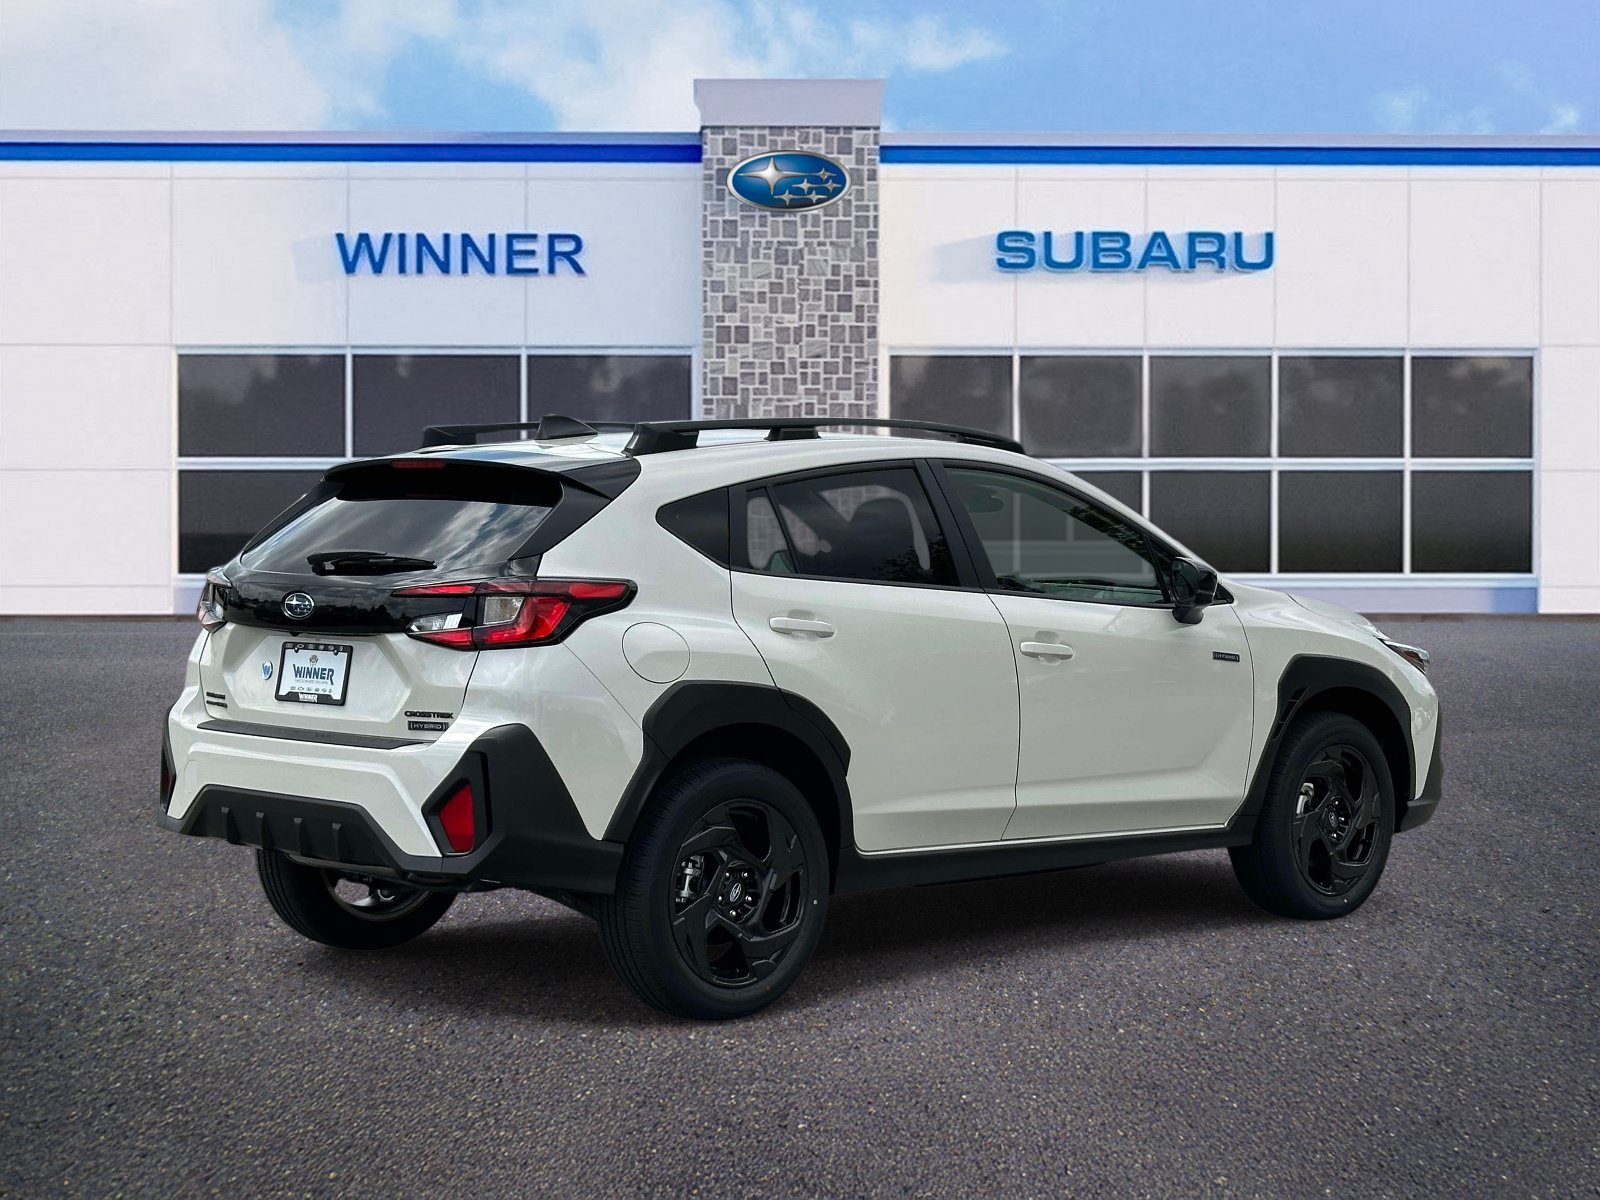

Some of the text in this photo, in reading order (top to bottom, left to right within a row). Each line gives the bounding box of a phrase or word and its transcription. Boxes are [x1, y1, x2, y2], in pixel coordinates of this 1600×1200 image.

[335, 232, 586, 275] WINNER
[996, 231, 1274, 271] SUBARU
[293, 664, 334, 685] WINNER
[404, 710, 454, 719] CROSSTREK
